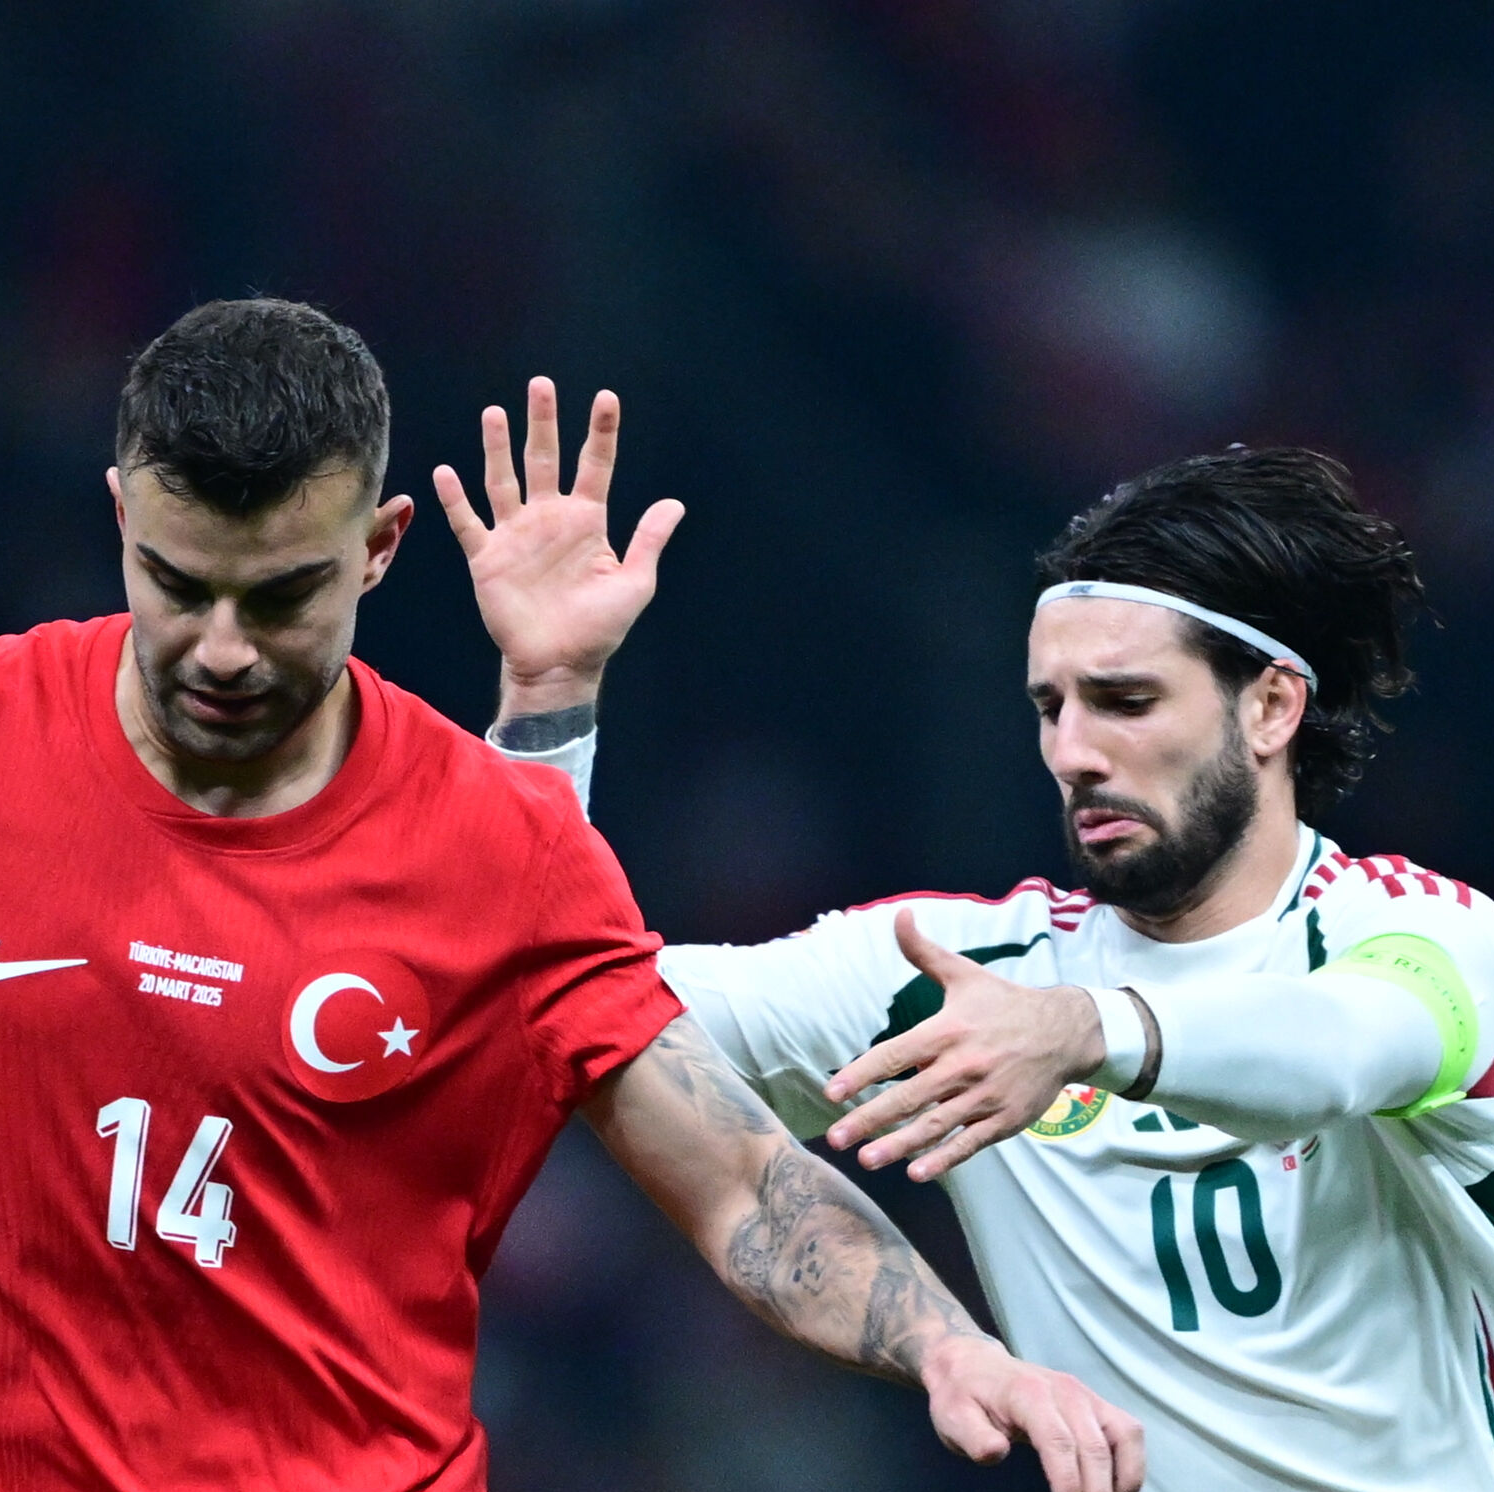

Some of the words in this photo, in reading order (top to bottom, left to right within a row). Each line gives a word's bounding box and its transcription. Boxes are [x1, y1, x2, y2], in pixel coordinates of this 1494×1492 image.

[129, 940, 244, 982] TÜRKİYE-MACARİSTAN
[138, 973, 156, 993] 20
[155, 976, 193, 1001] MART
[191, 984, 224, 1007] 2025
[96, 1096, 236, 1268] 14
[1150, 1158, 1282, 1332] 10
